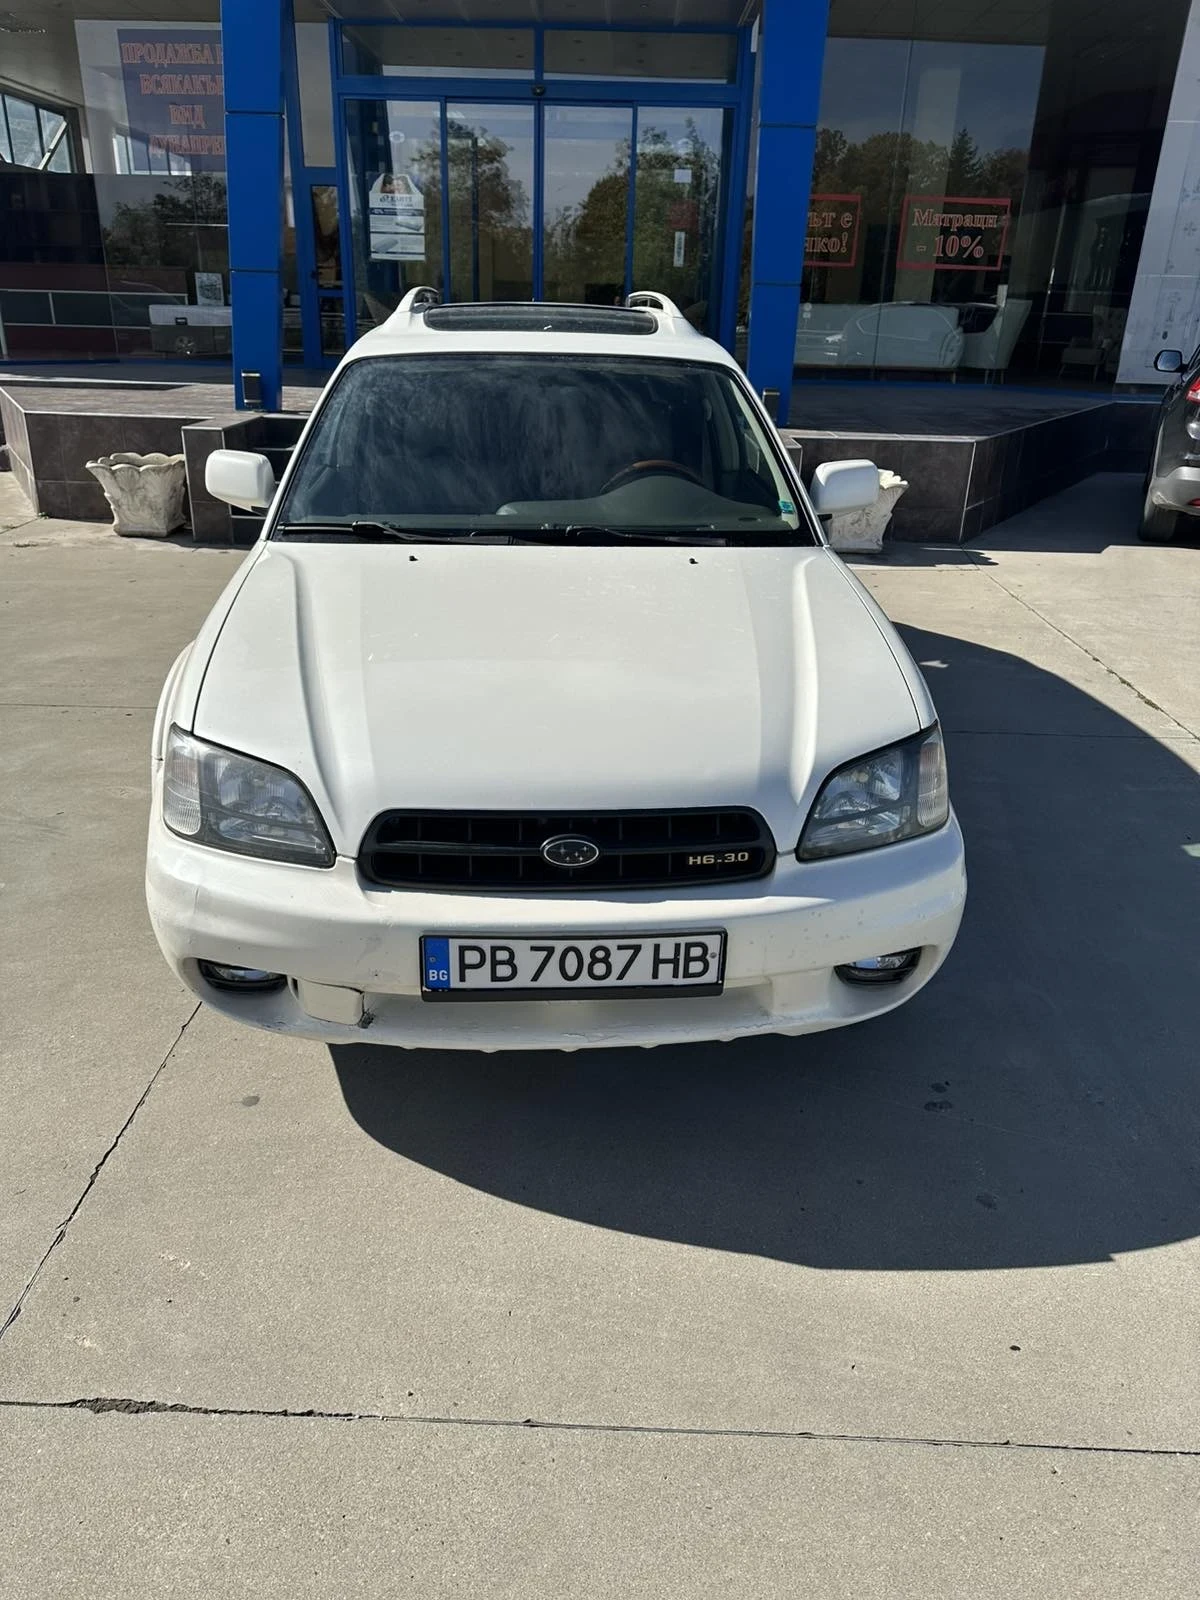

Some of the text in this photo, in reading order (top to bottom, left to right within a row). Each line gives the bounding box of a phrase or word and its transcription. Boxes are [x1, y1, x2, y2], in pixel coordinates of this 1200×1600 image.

[121, 43, 214, 68] ПРОДАЖБА
[169, 104, 207, 129] ВИД
[912, 208, 998, 231] Матраци
[932, 234, 985, 258] 10%
[457, 941, 711, 983] PB 7087 HB
[428, 969, 448, 982] BG
